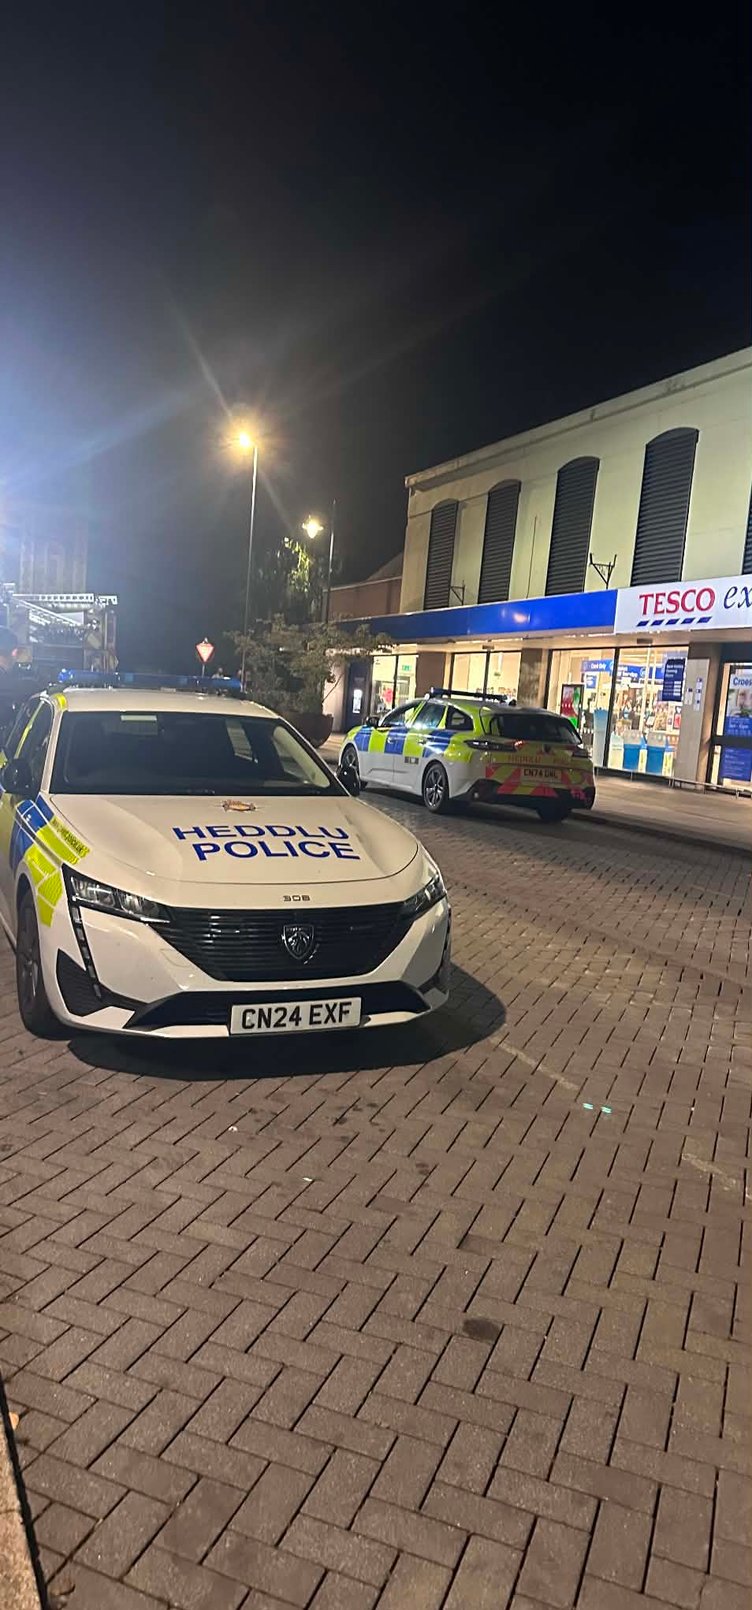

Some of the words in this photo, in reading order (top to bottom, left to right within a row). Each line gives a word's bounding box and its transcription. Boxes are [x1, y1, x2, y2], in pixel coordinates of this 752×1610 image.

[639, 587, 716, 615] TESCO
[723, 585, 752, 609] ex
[172, 825, 349, 840] HEDDLU
[192, 841, 361, 861] POLICE
[283, 894, 311, 902] 308
[241, 1005, 302, 1030] CN24
[308, 1001, 353, 1026] EXF
